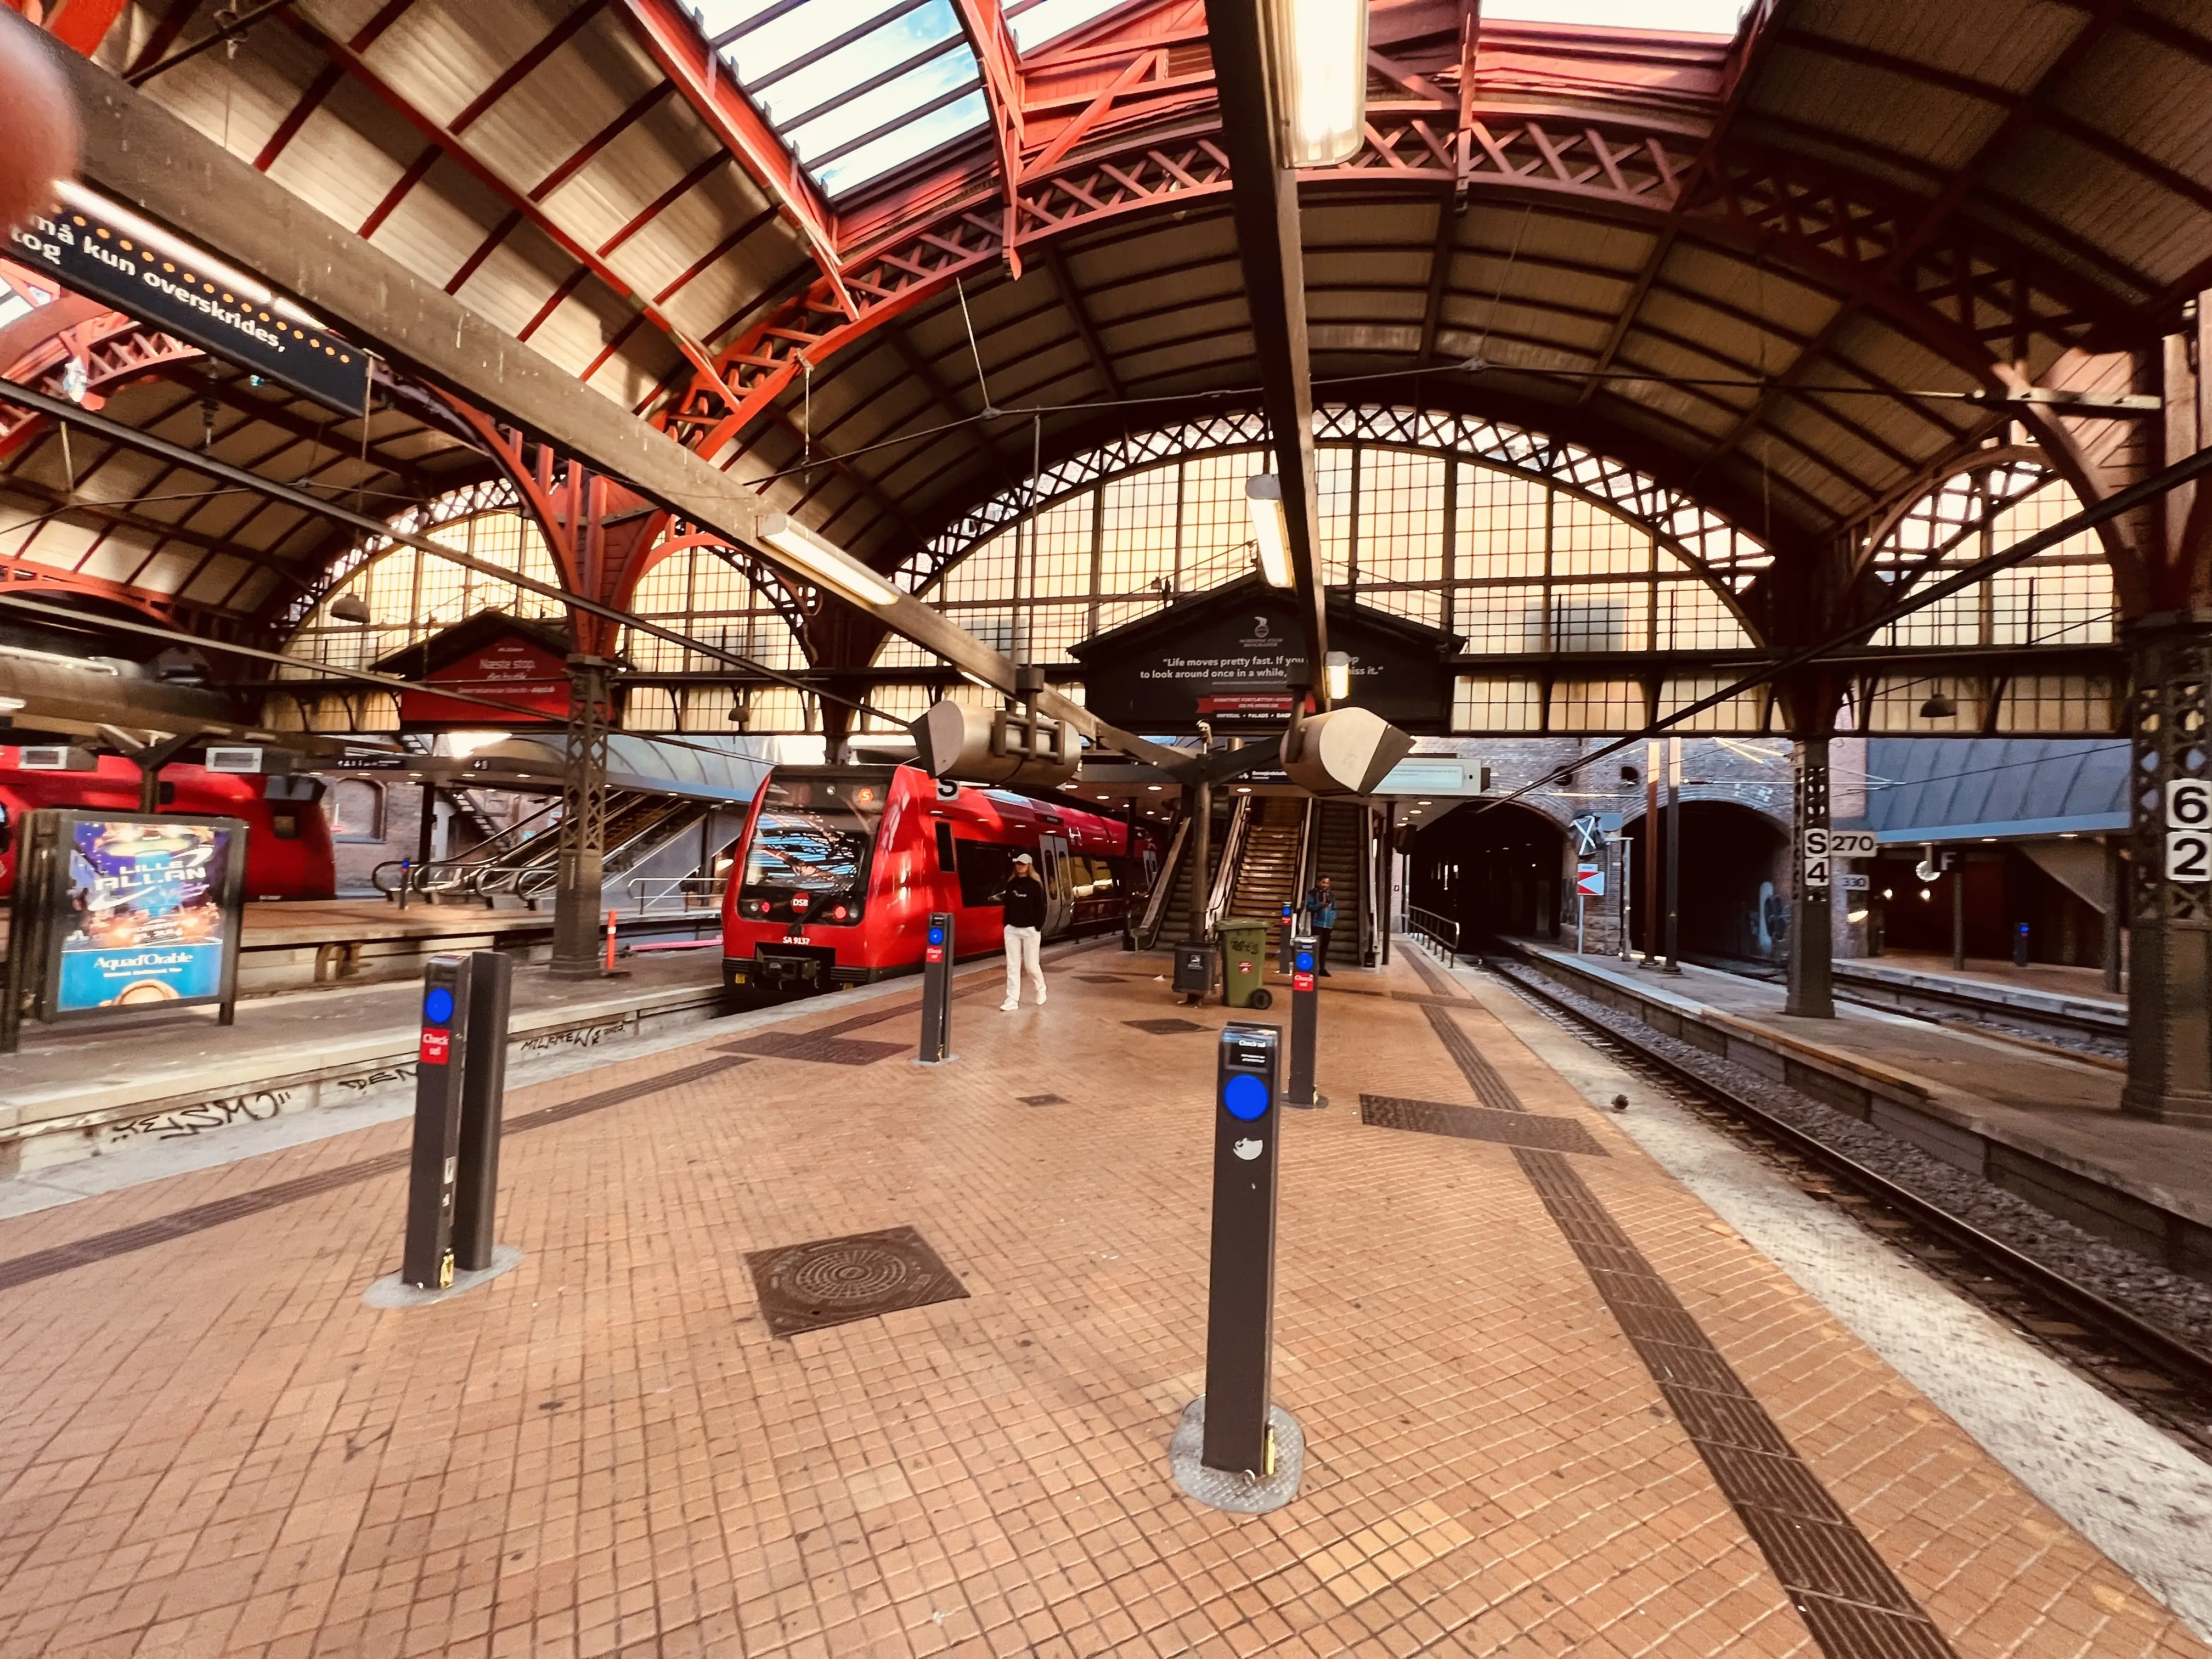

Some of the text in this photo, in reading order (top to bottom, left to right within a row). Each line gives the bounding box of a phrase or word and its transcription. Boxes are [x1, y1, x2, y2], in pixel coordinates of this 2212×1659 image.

[83, 235, 136, 276] kun
[143, 272, 285, 353] overskrides,
[1163, 658, 1185, 667] "Life
[1220, 658, 1250, 668] pretty
[1252, 656, 1273, 665] fast.
[1276, 656, 1284, 664] If
[1152, 669, 1173, 679] look
[1175, 669, 1209, 678] around
[1237, 669, 1246, 677] in
[1256, 668, 1287, 678] while,
[938, 778, 957, 797] S
[2174, 786, 2208, 824] 6
[1807, 832, 1827, 854] S
[1831, 836, 1874, 851] 270
[1941, 851, 1957, 871] F
[2174, 838, 2207, 876] 2
[119, 860, 184, 874] LILLE
[1807, 861, 1827, 883] 4
[792, 898, 809, 907] DSB
[422, 1032, 449, 1046] Check
[429, 1046, 442, 1056] ud
